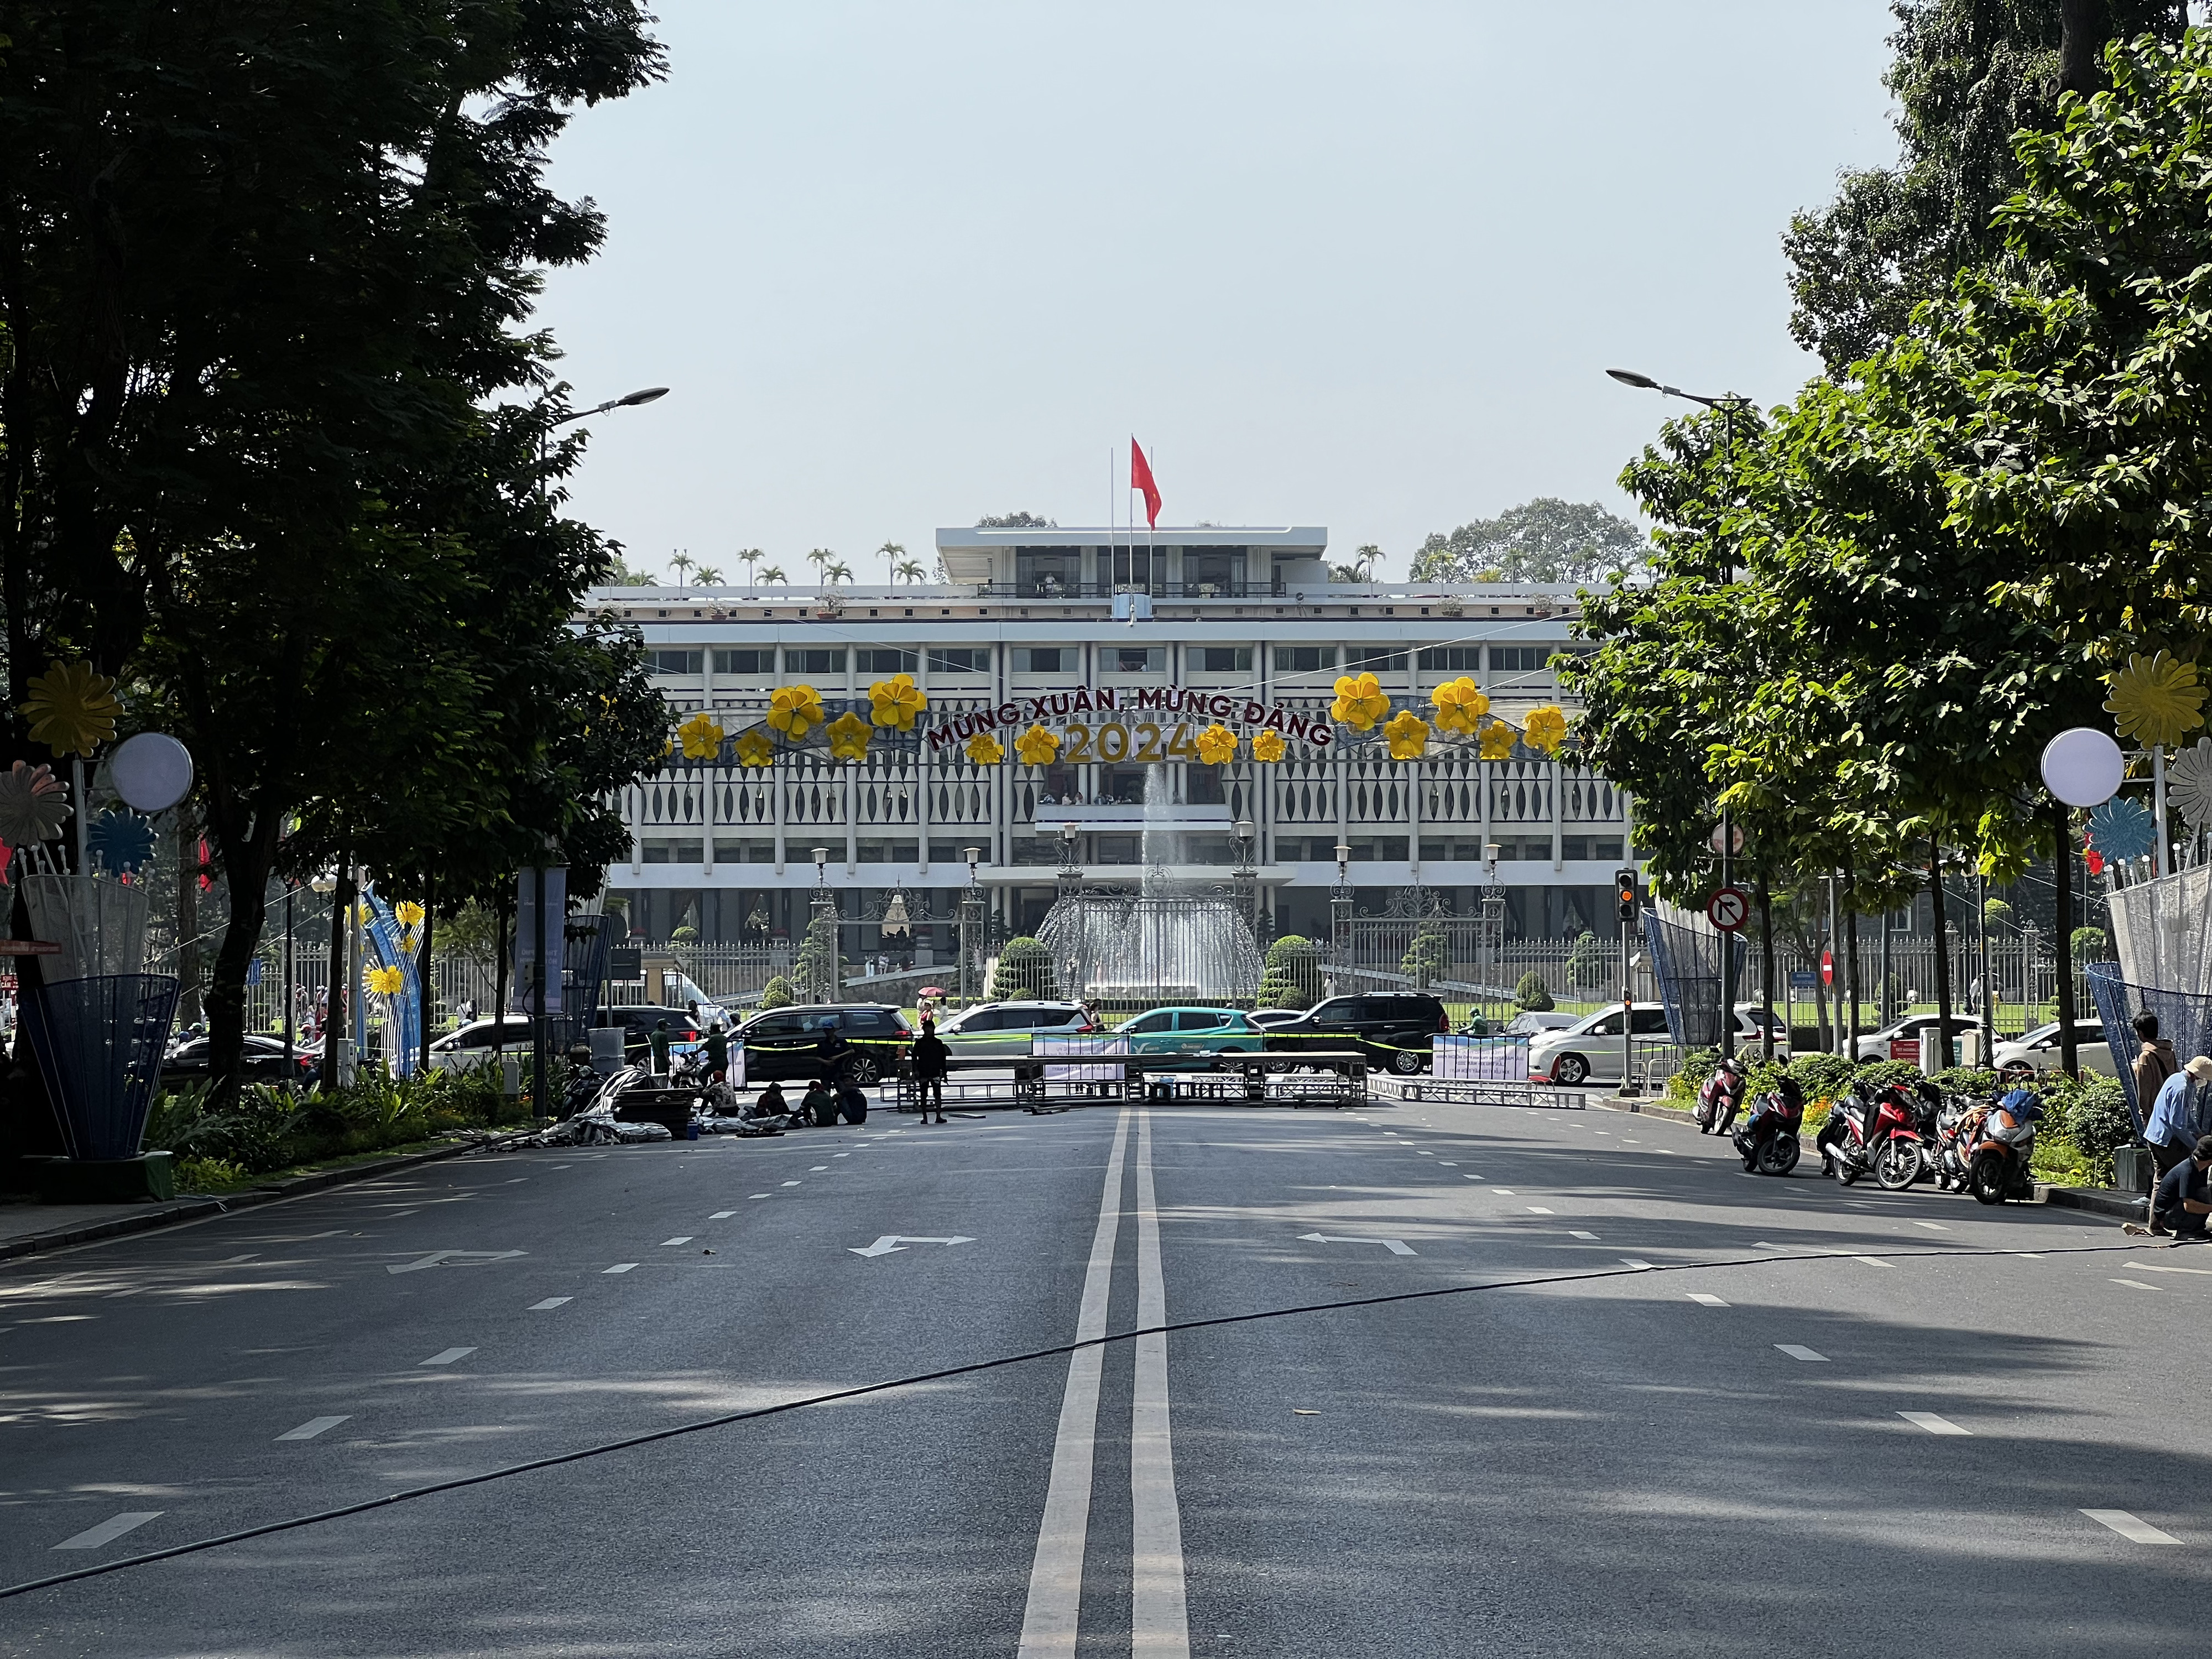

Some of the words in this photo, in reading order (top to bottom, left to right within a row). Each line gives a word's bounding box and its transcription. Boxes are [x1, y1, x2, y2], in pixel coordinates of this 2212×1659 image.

[927, 702, 1021, 750] MỪNG
[1029, 685, 1125, 719] XUÂN,
[1138, 685, 1232, 717] MỪNG
[1244, 702, 1332, 745] ĐẢNG
[1065, 722, 1198, 763] 2024
